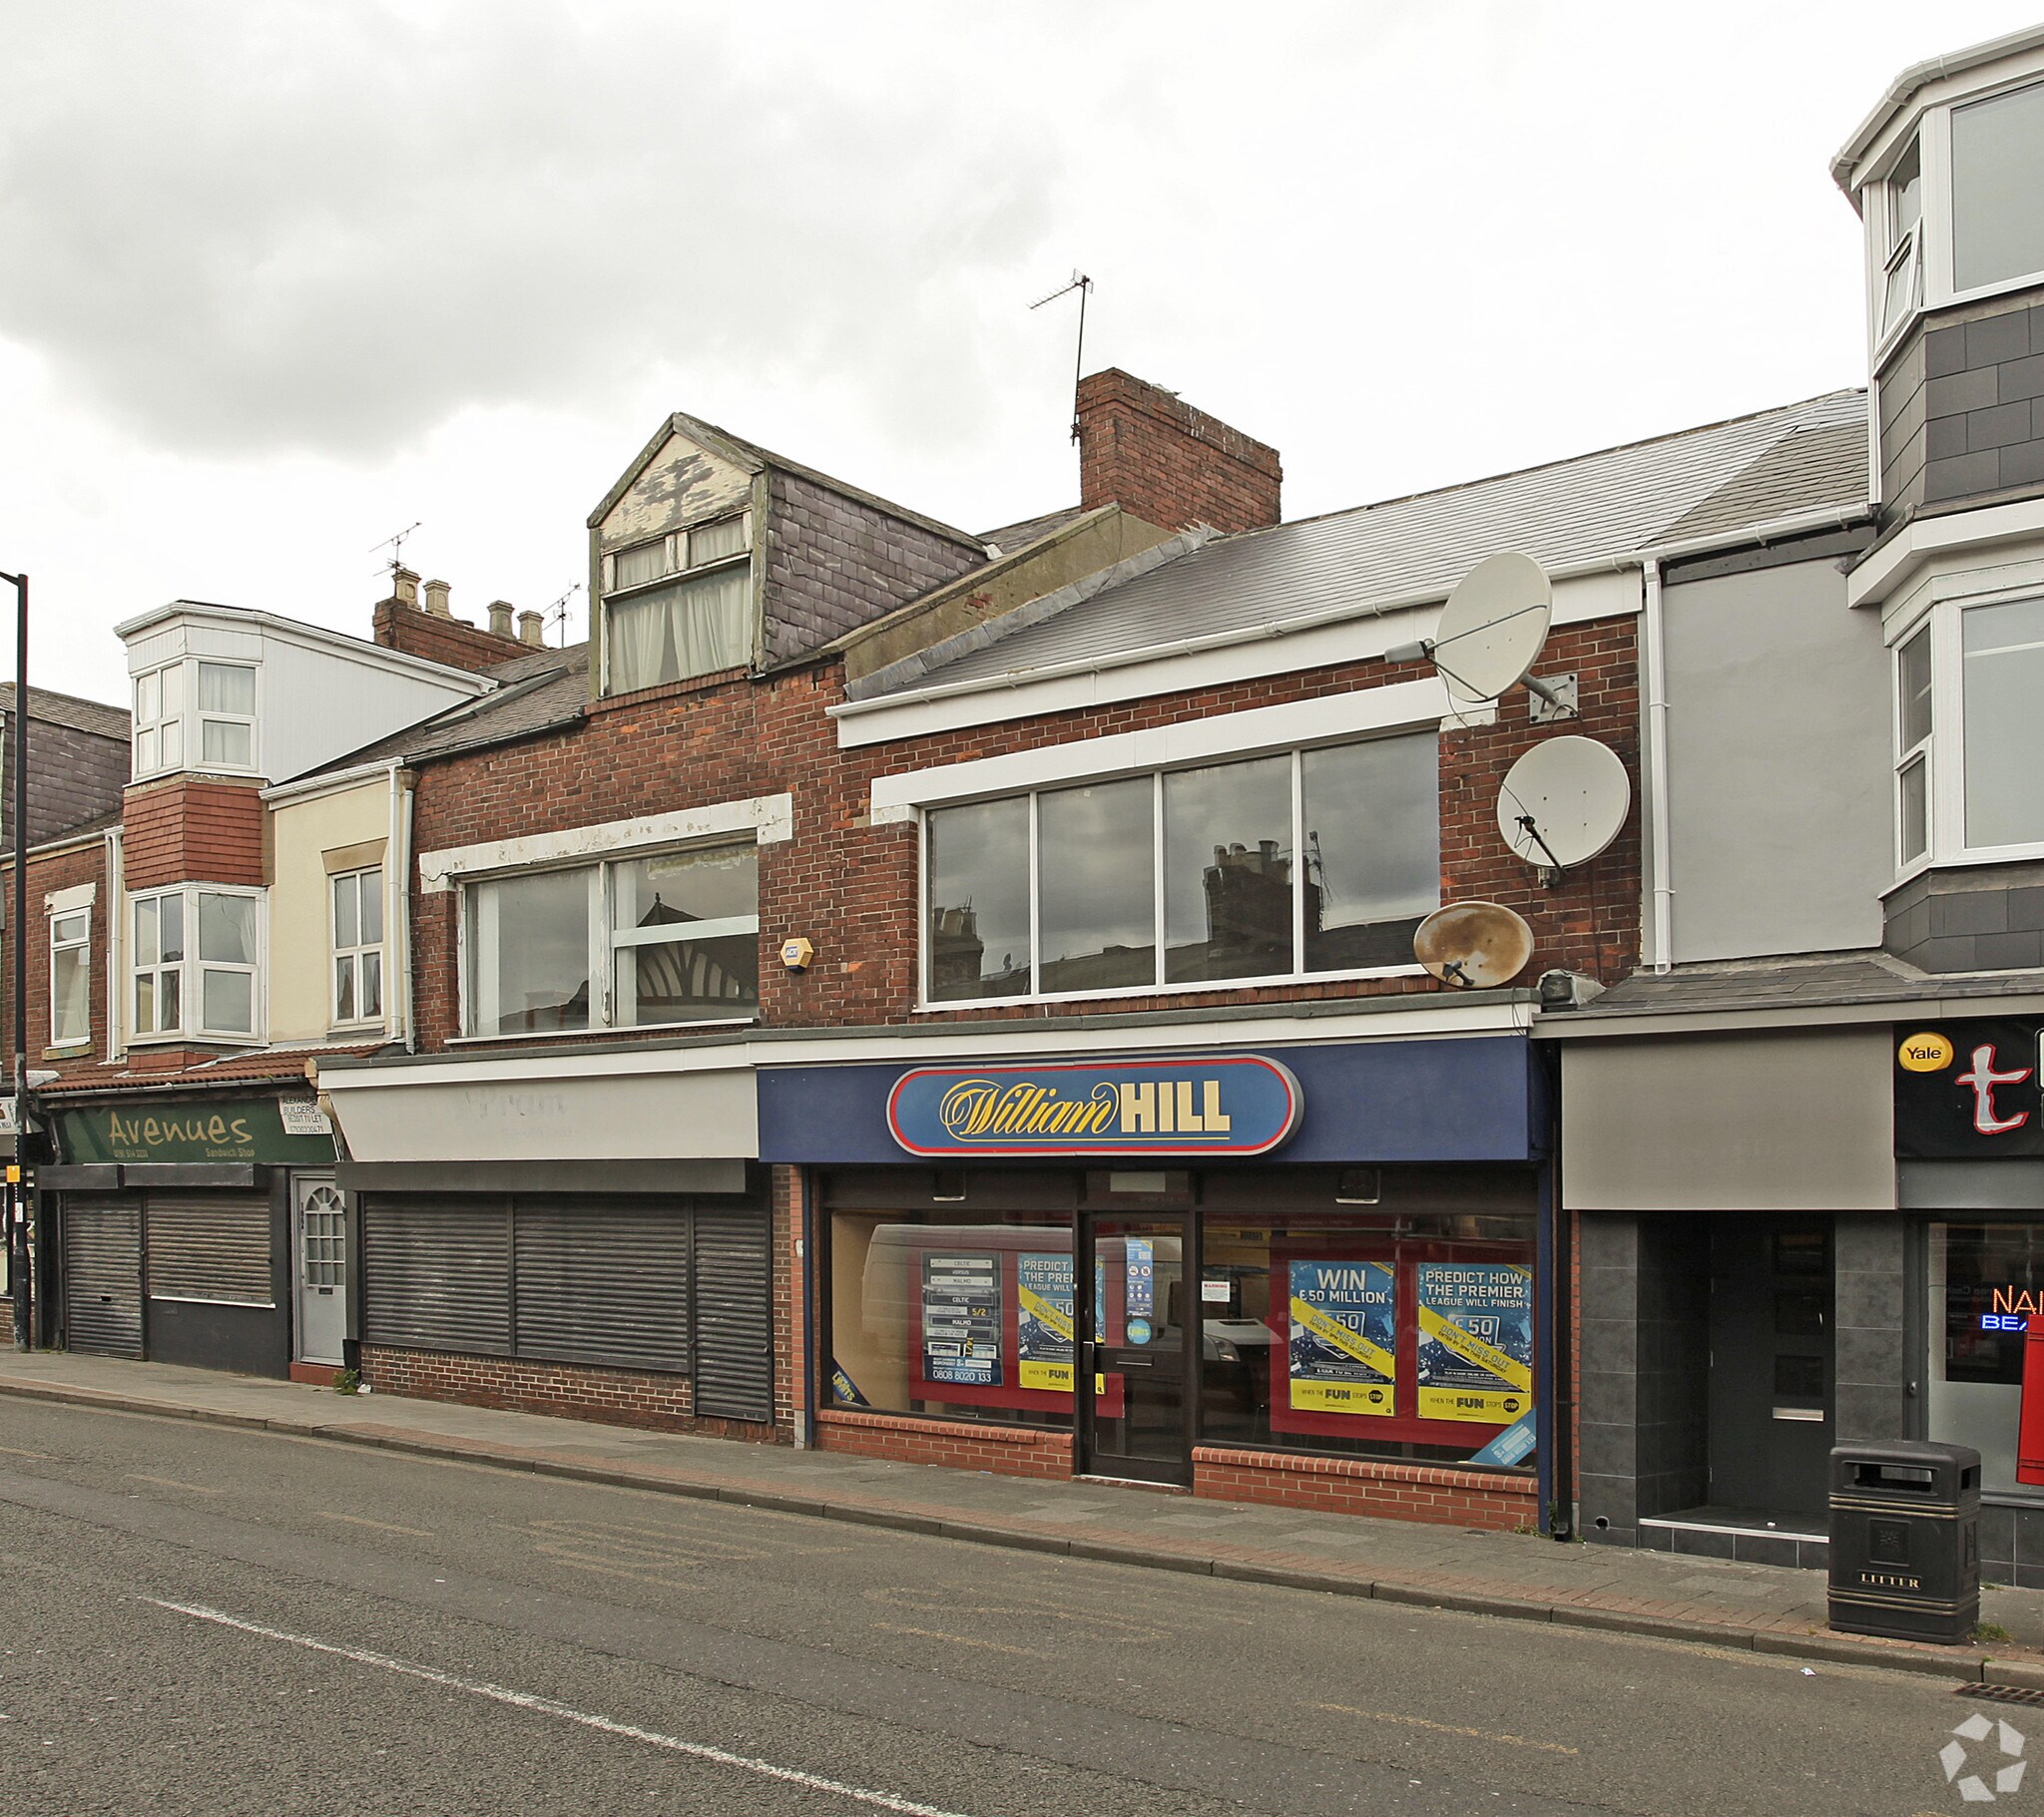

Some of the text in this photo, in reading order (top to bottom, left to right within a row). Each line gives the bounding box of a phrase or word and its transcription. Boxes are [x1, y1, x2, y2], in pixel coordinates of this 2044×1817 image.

[1906, 1047, 1941, 1060] Yale
[283, 1105, 315, 1115] BUILDERS
[939, 1079, 1231, 1135] William HILL
[108, 1111, 254, 1146] Avenues
[206, 1147, 256, 1158] Sandwich Shop
[1024, 1260, 1068, 1271] PREDICT
[1024, 1272, 1044, 1282] THE
[1316, 1268, 1366, 1290] WIN
[1425, 1271, 1523, 1284] PREDICT HOW
[1298, 1289, 1385, 1303] £50 MILLION
[1425, 1284, 1523, 1298] THE PREMIER
[1425, 1297, 1523, 1308] LEAGUE WILL FINISH
[1311, 1314, 1375, 1356] DON'T MISS OUT
[1440, 1325, 1467, 1343] DON'T
[1467, 1341, 1490, 1357] MISS
[1491, 1354, 1511, 1368] OUT
[1481, 1357, 1507, 1373] SATURDAY
[933, 1369, 991, 1382] 0808 8020 133
[1049, 1369, 1069, 1379] FUN
[1324, 1389, 1351, 1400] FUN
[1456, 1397, 1484, 1409] FUN
[1861, 1573, 1919, 1589] LITTER
